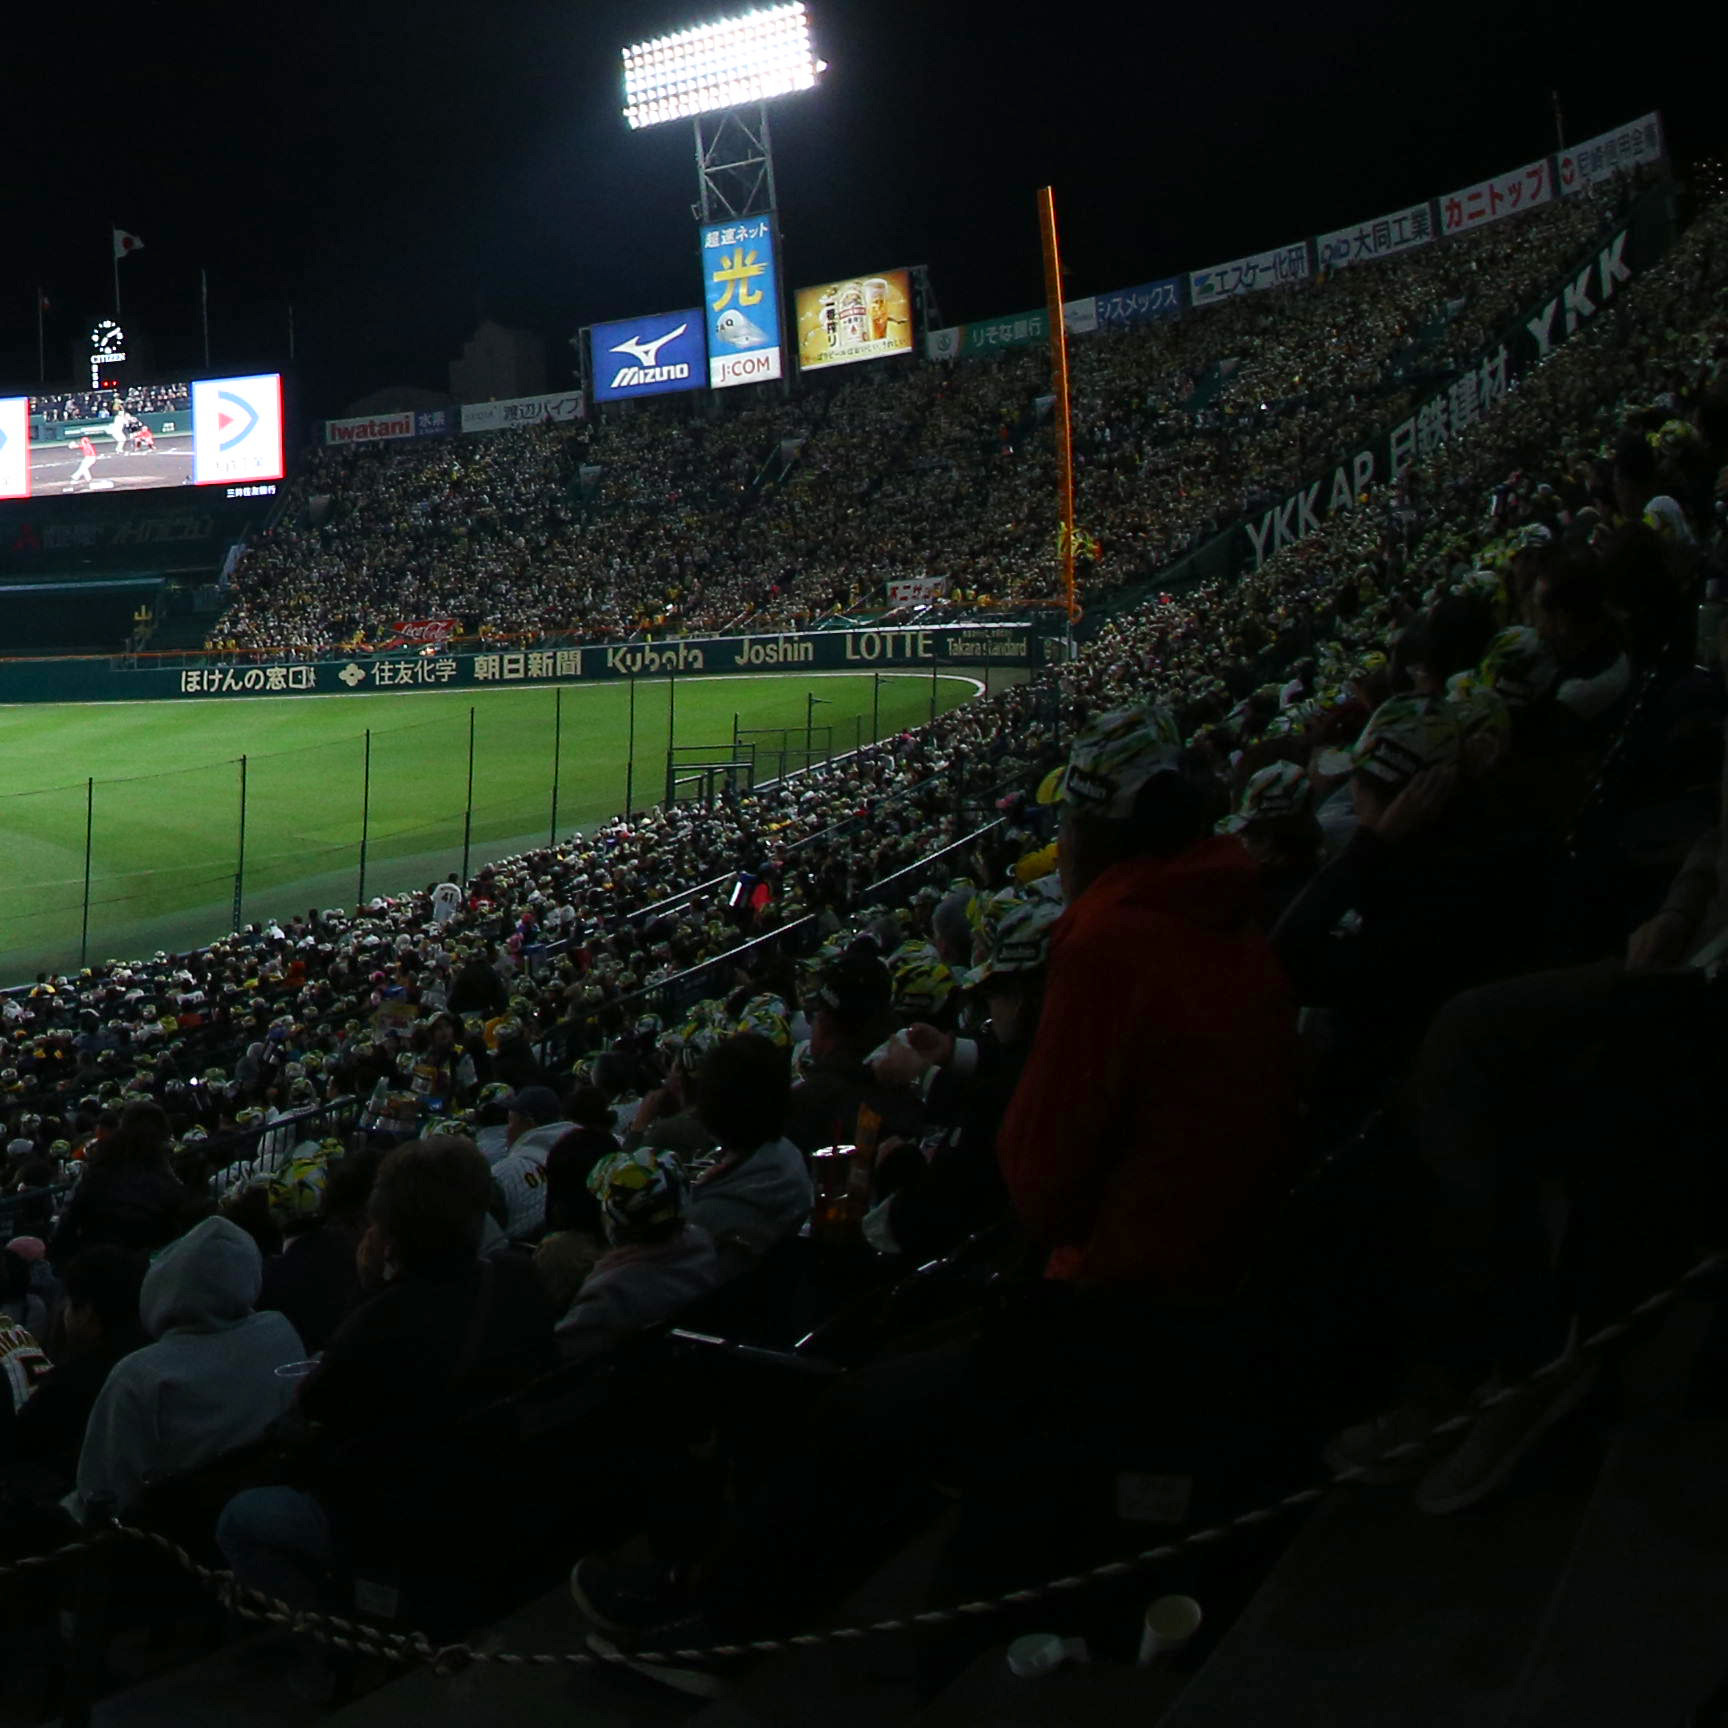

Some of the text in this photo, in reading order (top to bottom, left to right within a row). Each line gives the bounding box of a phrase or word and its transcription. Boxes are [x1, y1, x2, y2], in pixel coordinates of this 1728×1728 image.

[1444, 165, 1543, 229] カニトップ
[703, 223, 769, 249] 超速ネット
[1353, 200, 1431, 258] 大同工業
[712, 247, 769, 312] 光
[1526, 229, 1634, 356] YKK
[1097, 284, 1178, 321] シスメックス
[972, 317, 1041, 348] りそな銀行
[720, 356, 771, 383] J:COM
[330, 415, 411, 442] Iwatani
[1244, 450, 1377, 573] YKK AP
[607, 643, 704, 674] Kubota
[734, 636, 814, 666] Joshin
[845, 630, 934, 661] LOTTE
[180, 666, 306, 693] ほけんの窓口
[371, 658, 457, 685] 住友化学
[473, 650, 583, 681] 朝日新聞
